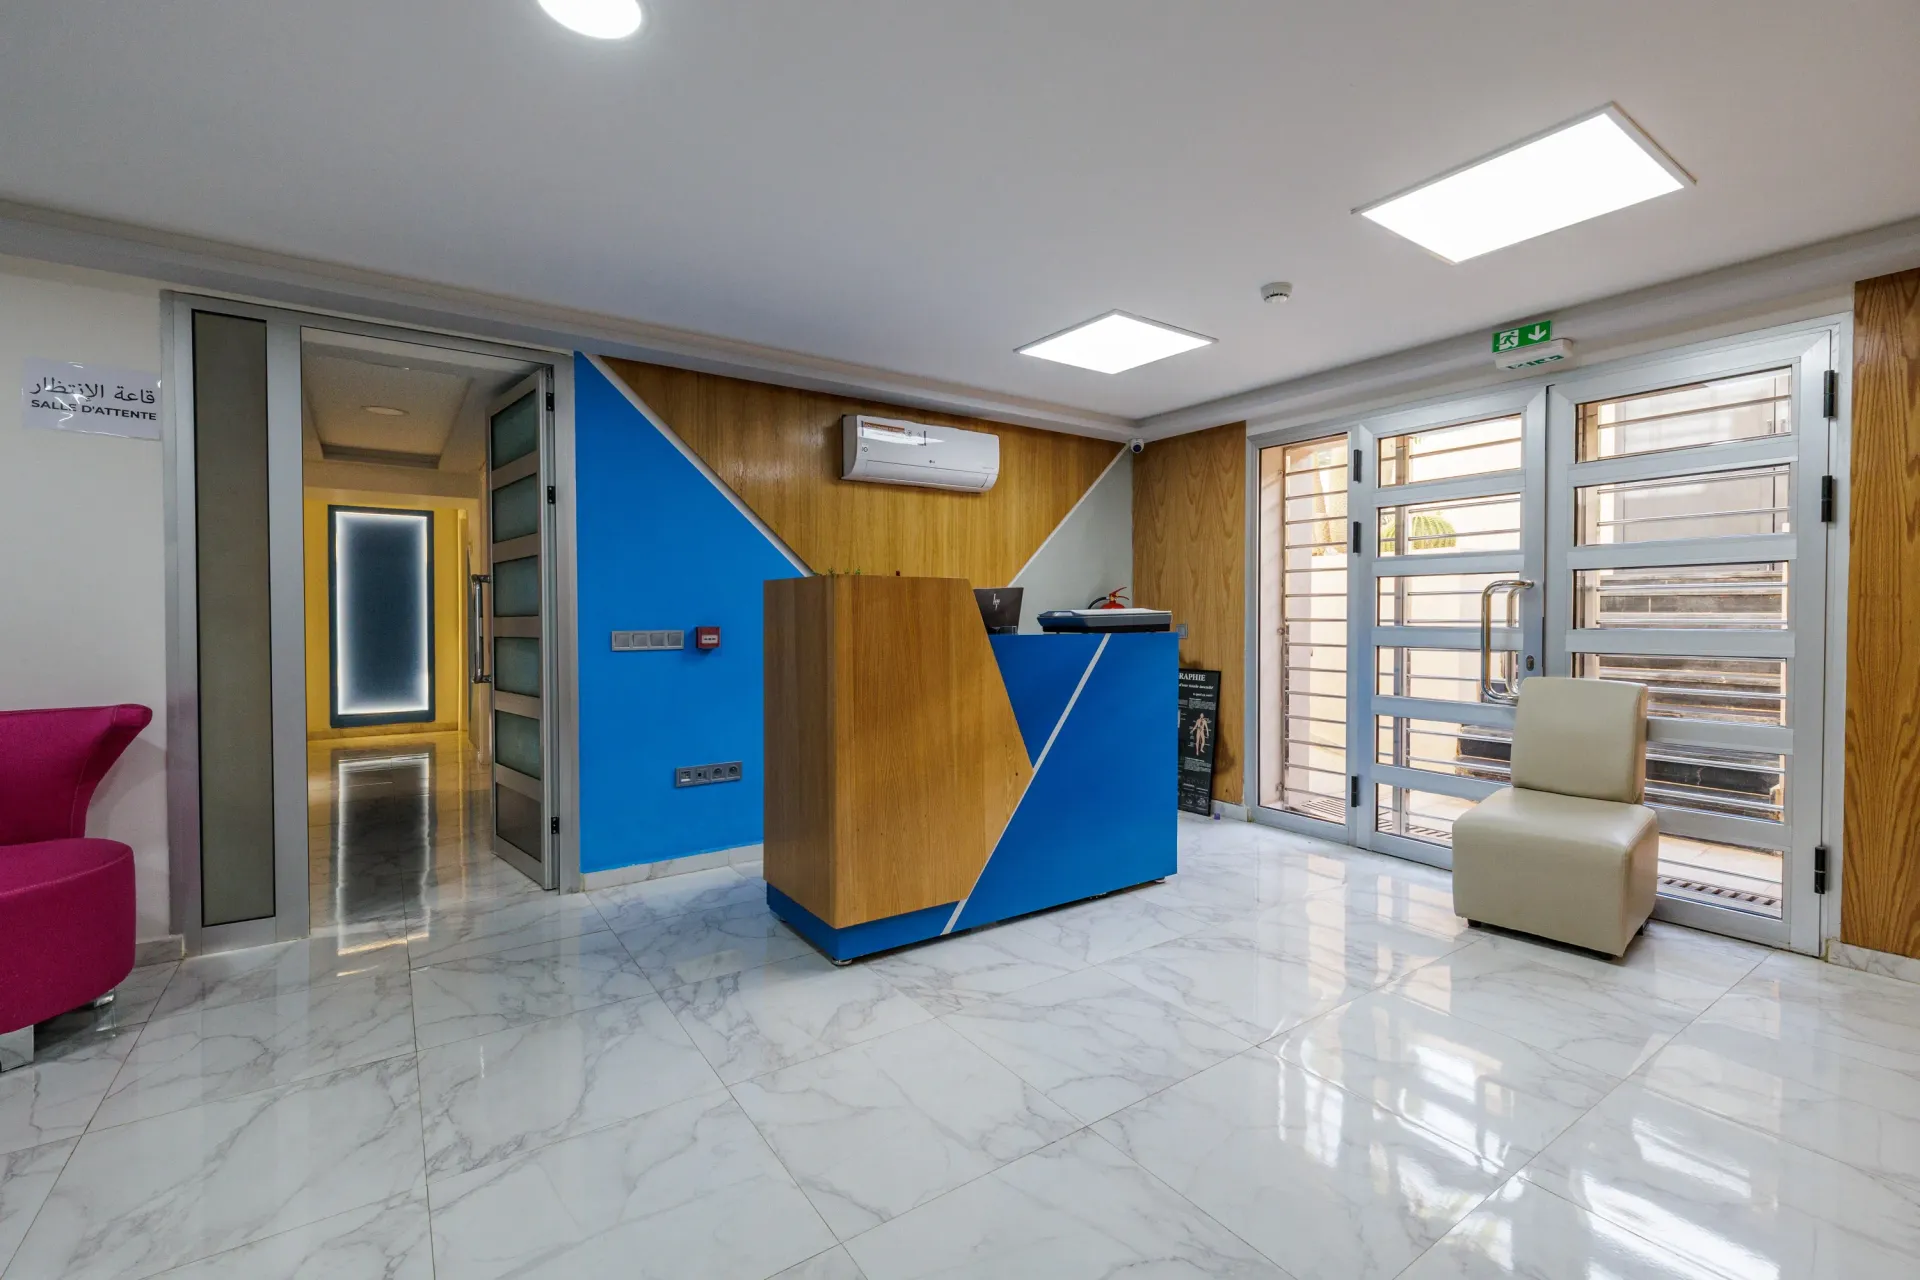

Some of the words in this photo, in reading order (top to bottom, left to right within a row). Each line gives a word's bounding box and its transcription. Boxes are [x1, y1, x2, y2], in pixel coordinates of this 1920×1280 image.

[114, 385, 155, 404] قاعة
[31, 400, 77, 412] SALLE
[81, 405, 157, 420] D'ATTENTE
